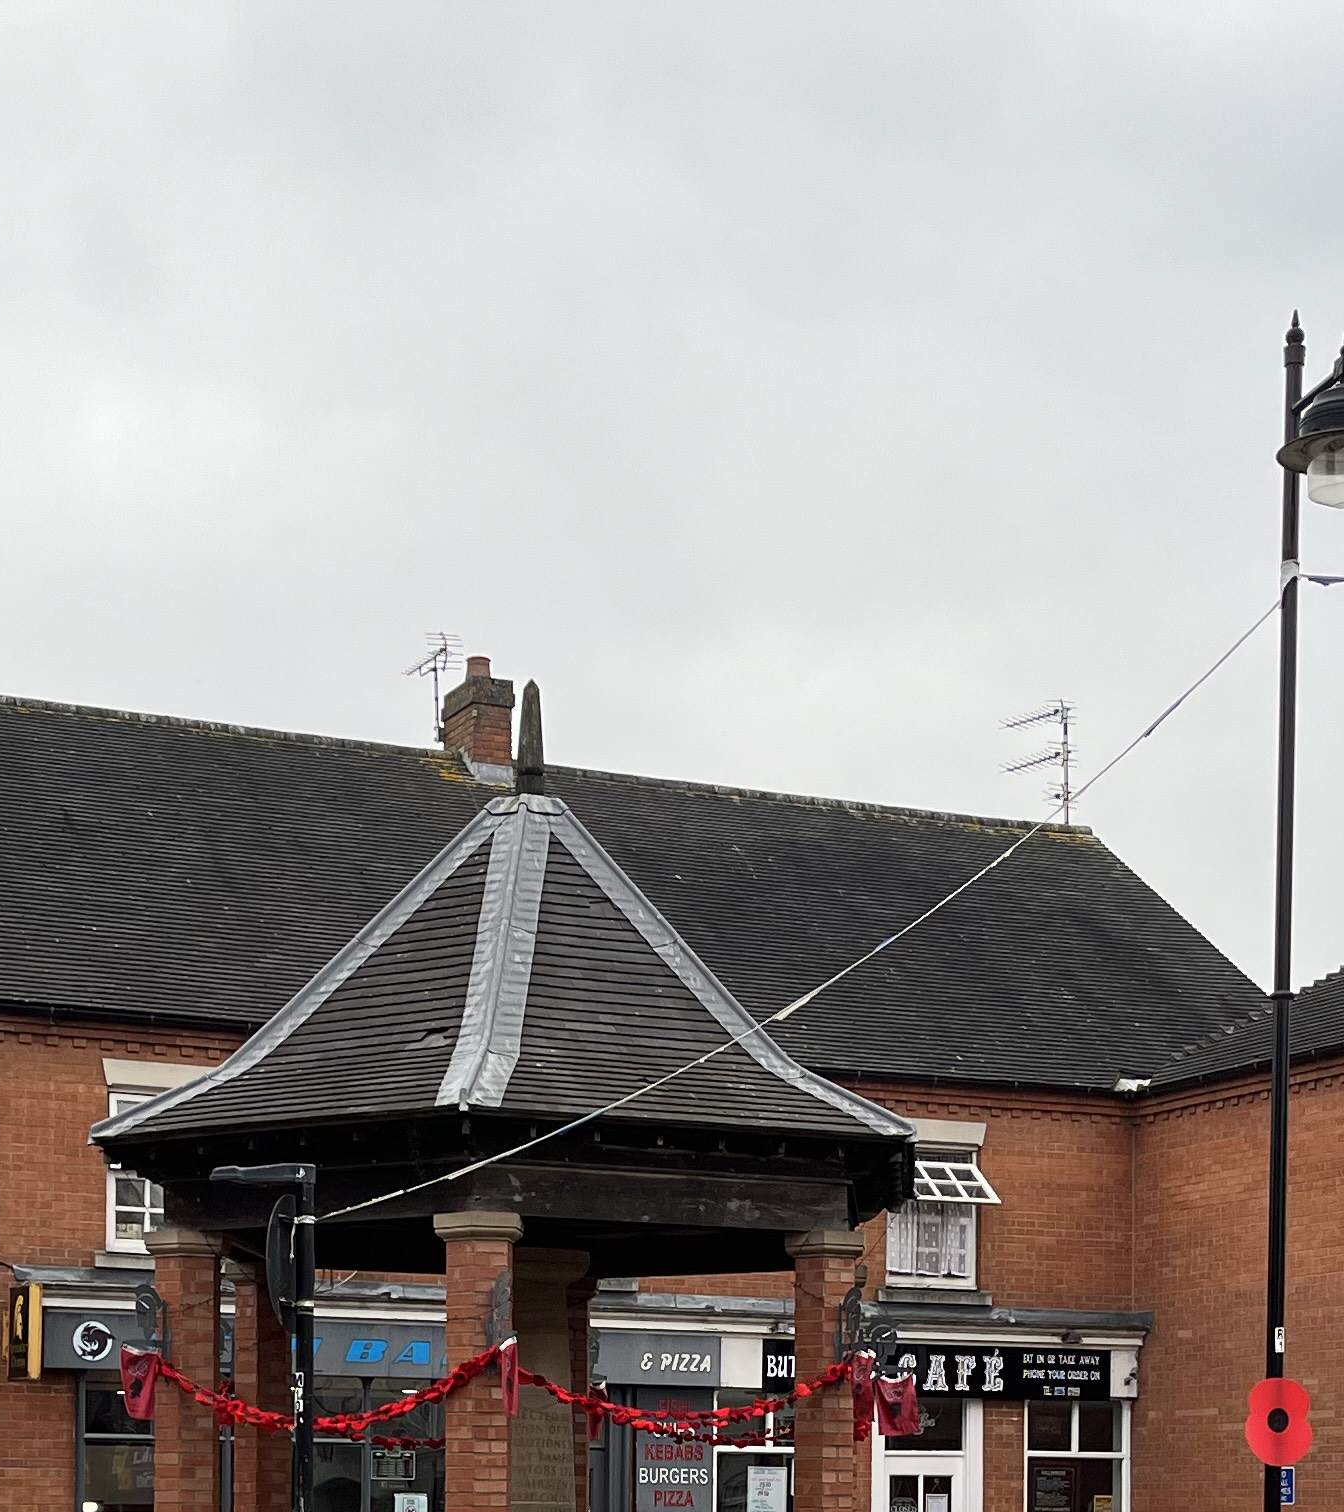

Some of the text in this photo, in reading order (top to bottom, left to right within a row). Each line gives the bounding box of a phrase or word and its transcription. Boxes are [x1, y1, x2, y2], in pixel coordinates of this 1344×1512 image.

[345, 1338, 446, 1367] BA
[1023, 1353, 1100, 1365] EAT IN OR TAKE AWAY
[640, 1352, 711, 1372] & PIZZA
[766, 1354, 795, 1378] BUT
[1023, 1369, 1100, 1380] PHONE YOUR ORDER ON
[644, 1444, 703, 1461] KEBABS
[639, 1468, 708, 1484] BURGERS
[654, 1490, 694, 1507] PIZZA
